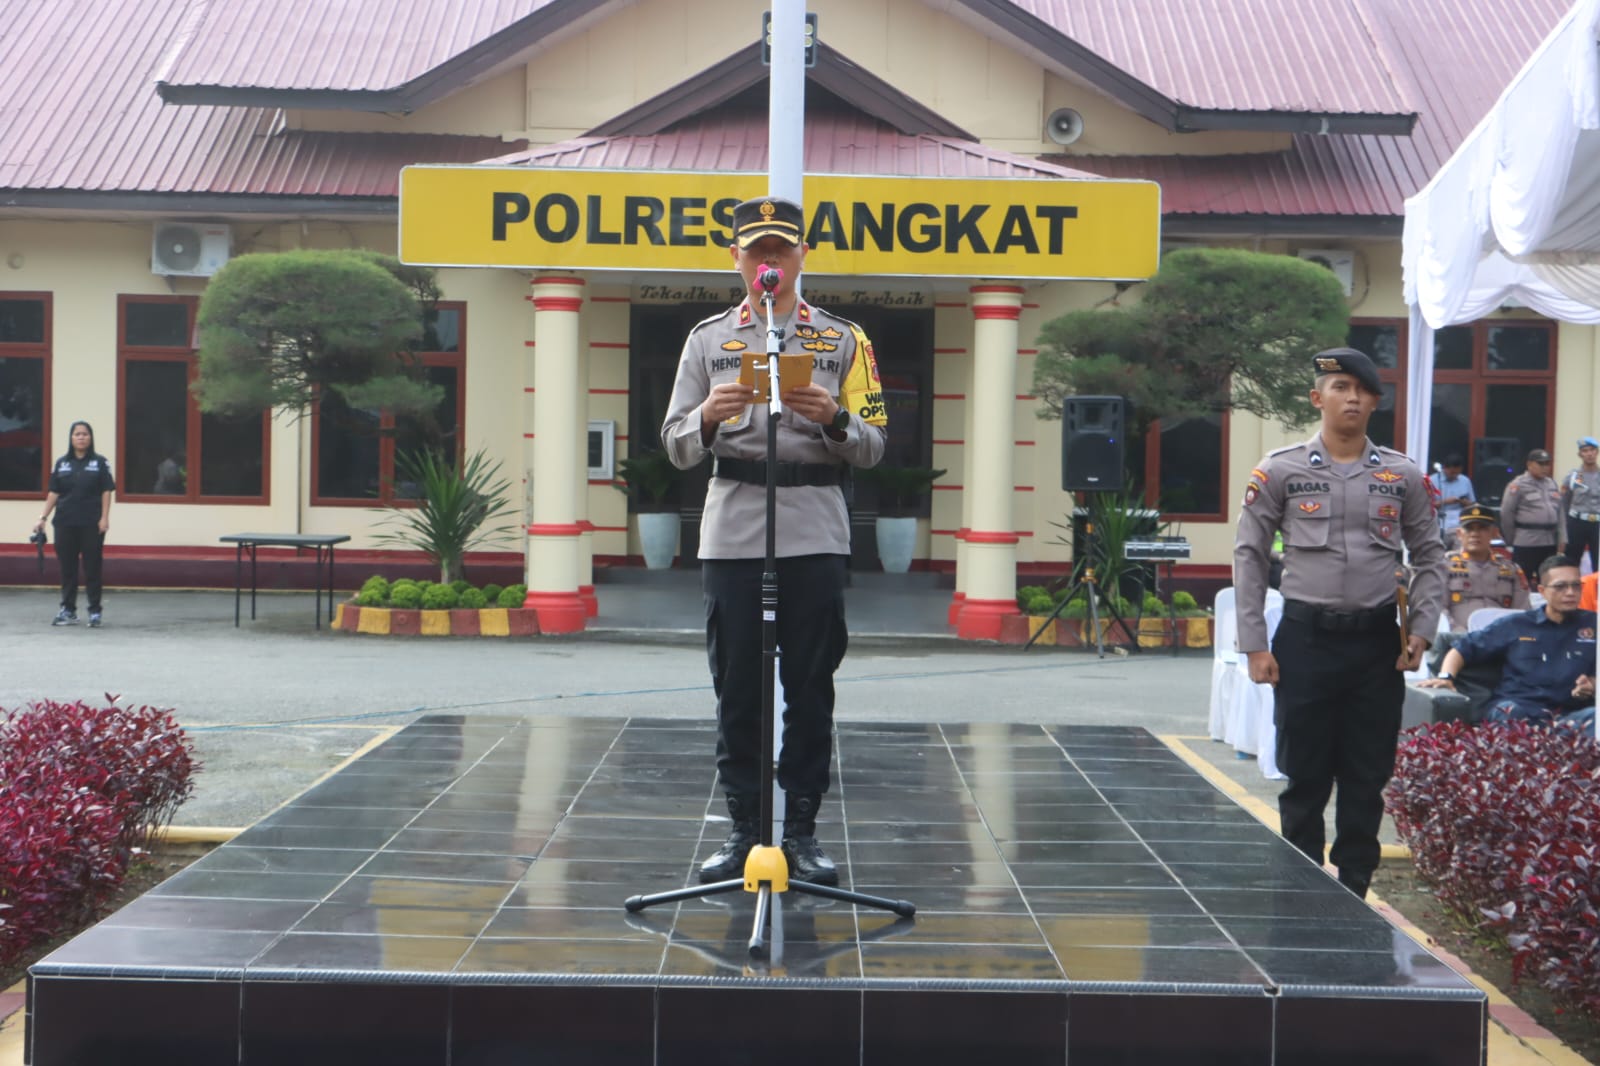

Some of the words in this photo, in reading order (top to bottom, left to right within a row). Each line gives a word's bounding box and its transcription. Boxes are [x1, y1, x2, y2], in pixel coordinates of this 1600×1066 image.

[492, 192, 745, 249] POLRES
[805, 201, 1078, 255] ANGKAT
[640, 285, 719, 300] Tekadku
[851, 290, 925, 305] Terbaik
[711, 357, 742, 372] HEND
[859, 404, 887, 419] OPS
[1287, 482, 1330, 494] BAGAS
